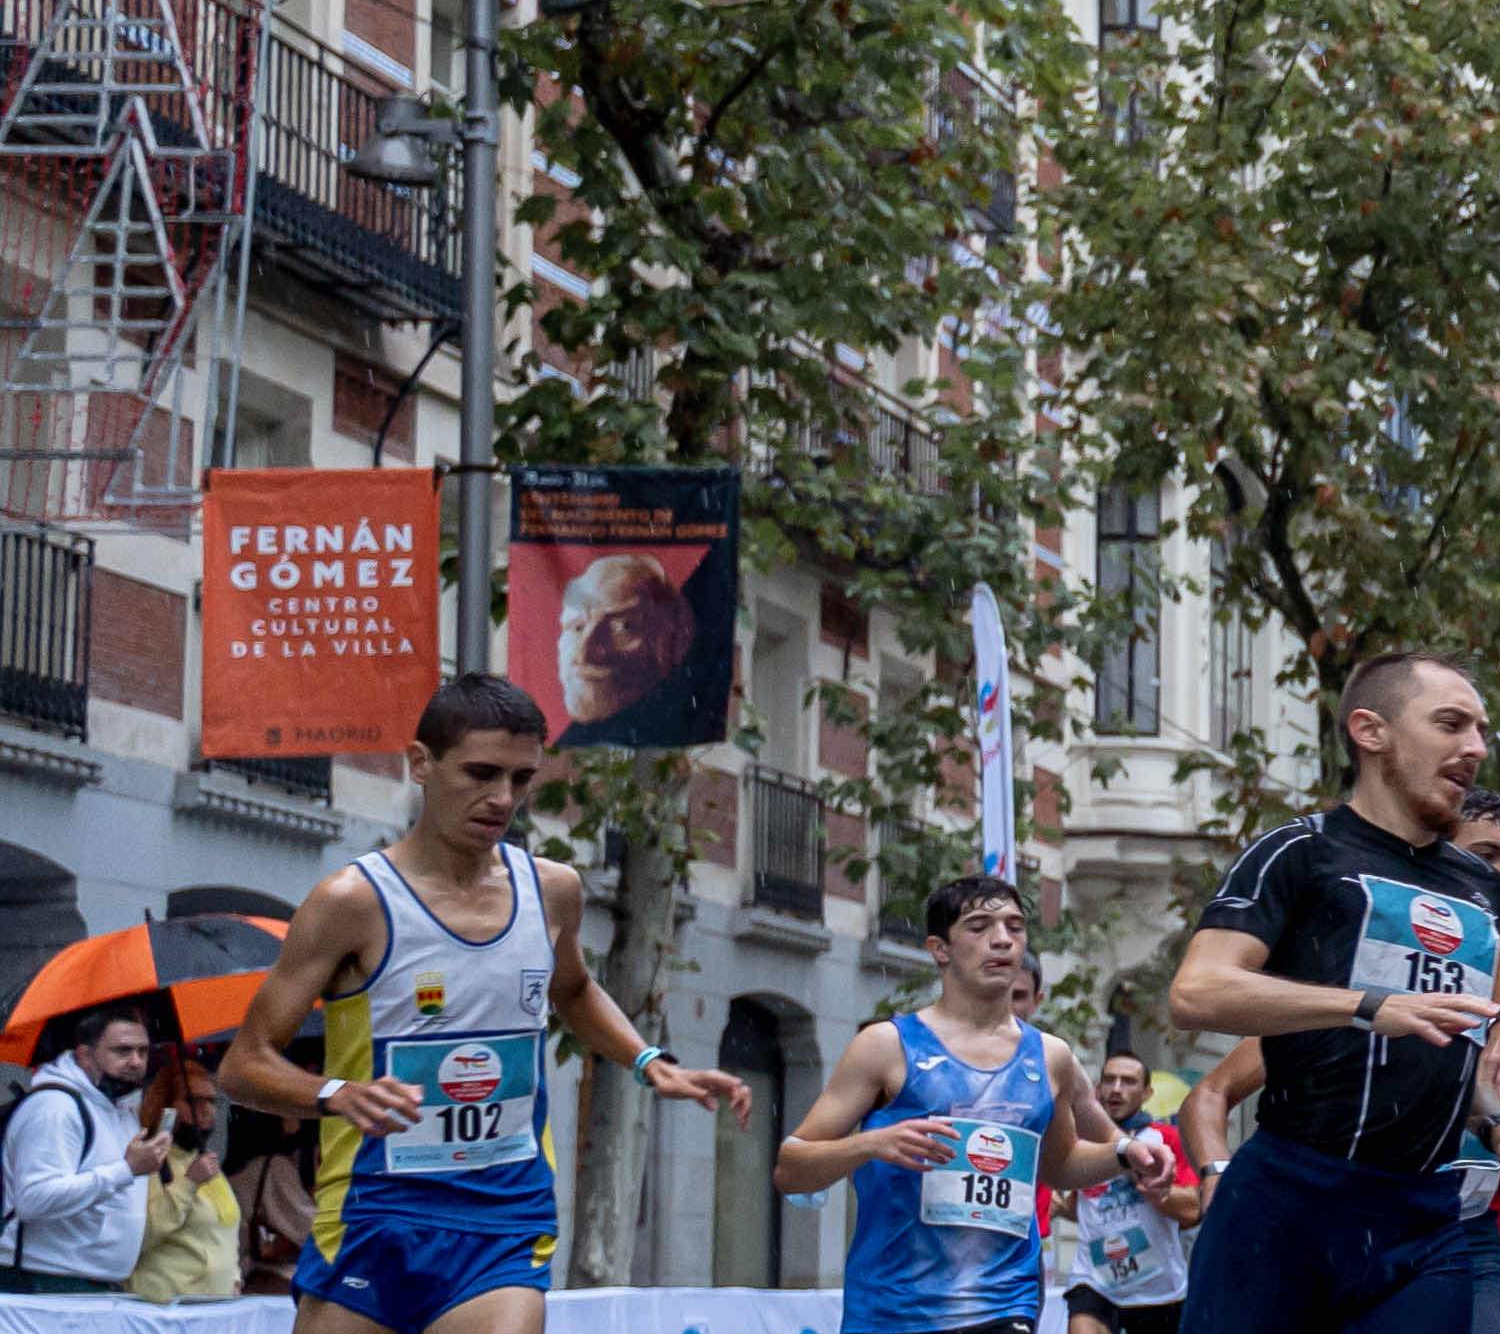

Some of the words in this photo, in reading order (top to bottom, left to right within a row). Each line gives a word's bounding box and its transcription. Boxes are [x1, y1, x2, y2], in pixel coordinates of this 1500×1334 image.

[230, 517, 414, 555] FERNÁN
[230, 555, 414, 590] GÓMEZ
[268, 597, 380, 614] CENTRO
[251, 619, 395, 636] CULTURAL
[231, 641, 266, 658] DE
[282, 641, 316, 657] LA
[333, 638, 414, 655] VILLA
[293, 726, 382, 743] MADRID
[1405, 952, 1465, 994] 153
[436, 1102, 502, 1143] 102
[962, 1173, 1011, 1208] 138
